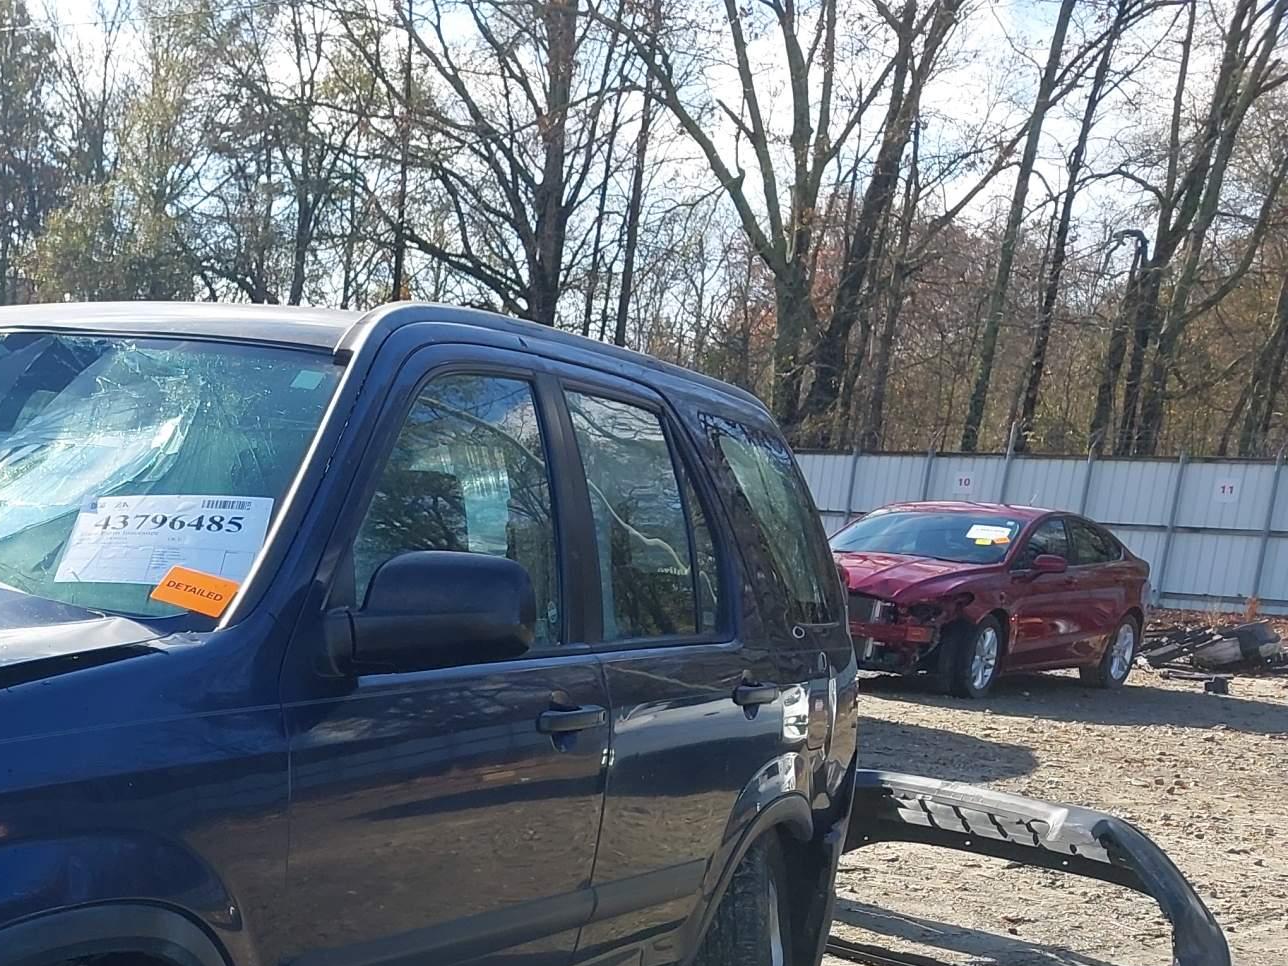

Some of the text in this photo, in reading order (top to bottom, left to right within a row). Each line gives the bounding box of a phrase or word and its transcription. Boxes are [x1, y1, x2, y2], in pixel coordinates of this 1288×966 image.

[958, 478, 971, 487] 10
[1220, 485, 1234, 494] 11
[95, 514, 244, 533] 43796485
[166, 580, 223, 601] DETAILED
